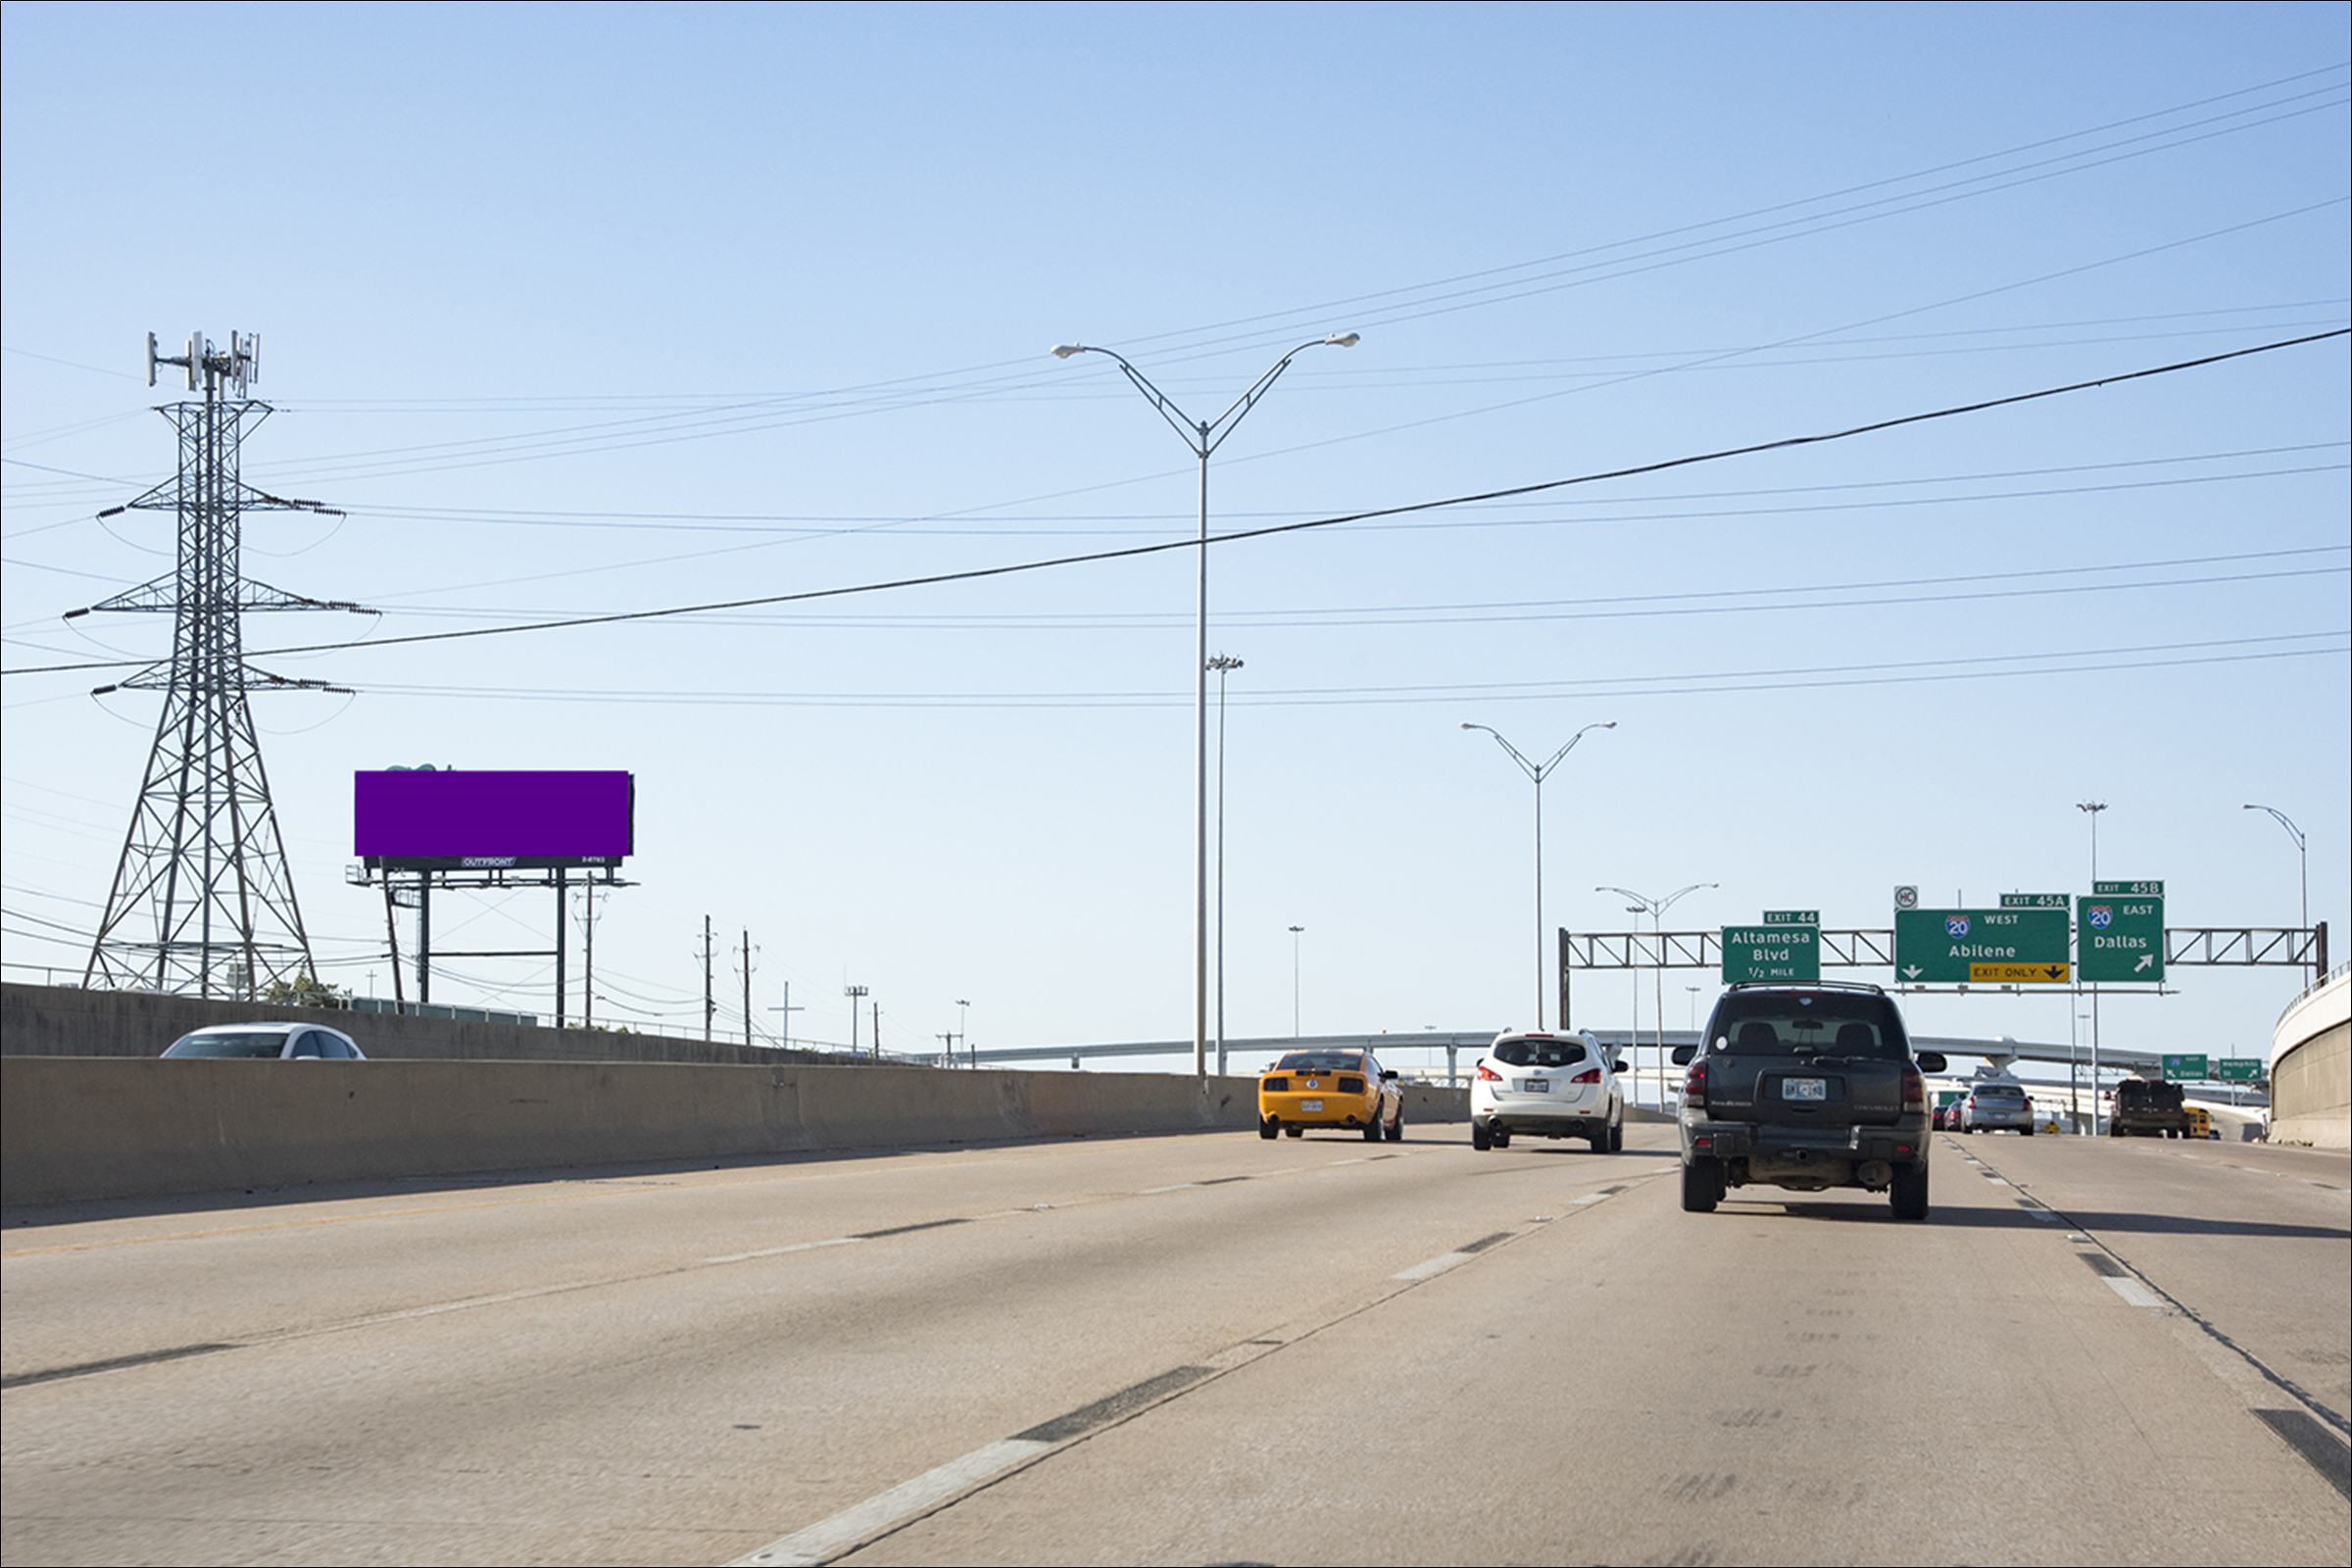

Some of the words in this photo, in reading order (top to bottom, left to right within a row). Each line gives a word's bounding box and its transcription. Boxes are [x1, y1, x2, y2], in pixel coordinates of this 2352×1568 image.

[464, 857, 514, 867] OUTFRONT
[2131, 883, 2159, 894] 45B
[2004, 896, 2031, 906] EXIT
[2036, 896, 2065, 906] 45A
[1767, 912, 1791, 922] EXIT
[1798, 912, 1815, 922] 44
[2091, 911, 2111, 925] 20
[2123, 906, 2153, 914] EAST
[1949, 921, 1967, 934] 20
[1984, 914, 2019, 924] WEST
[1732, 932, 1810, 944] Altamesa
[2094, 935, 2147, 949] Dallas
[1753, 949, 1789, 960] Blvd
[1948, 945, 2016, 957] Abilene
[1770, 967, 1794, 976] MILE
[1974, 967, 1999, 977] EXIT
[2004, 967, 2037, 977] ONLY
